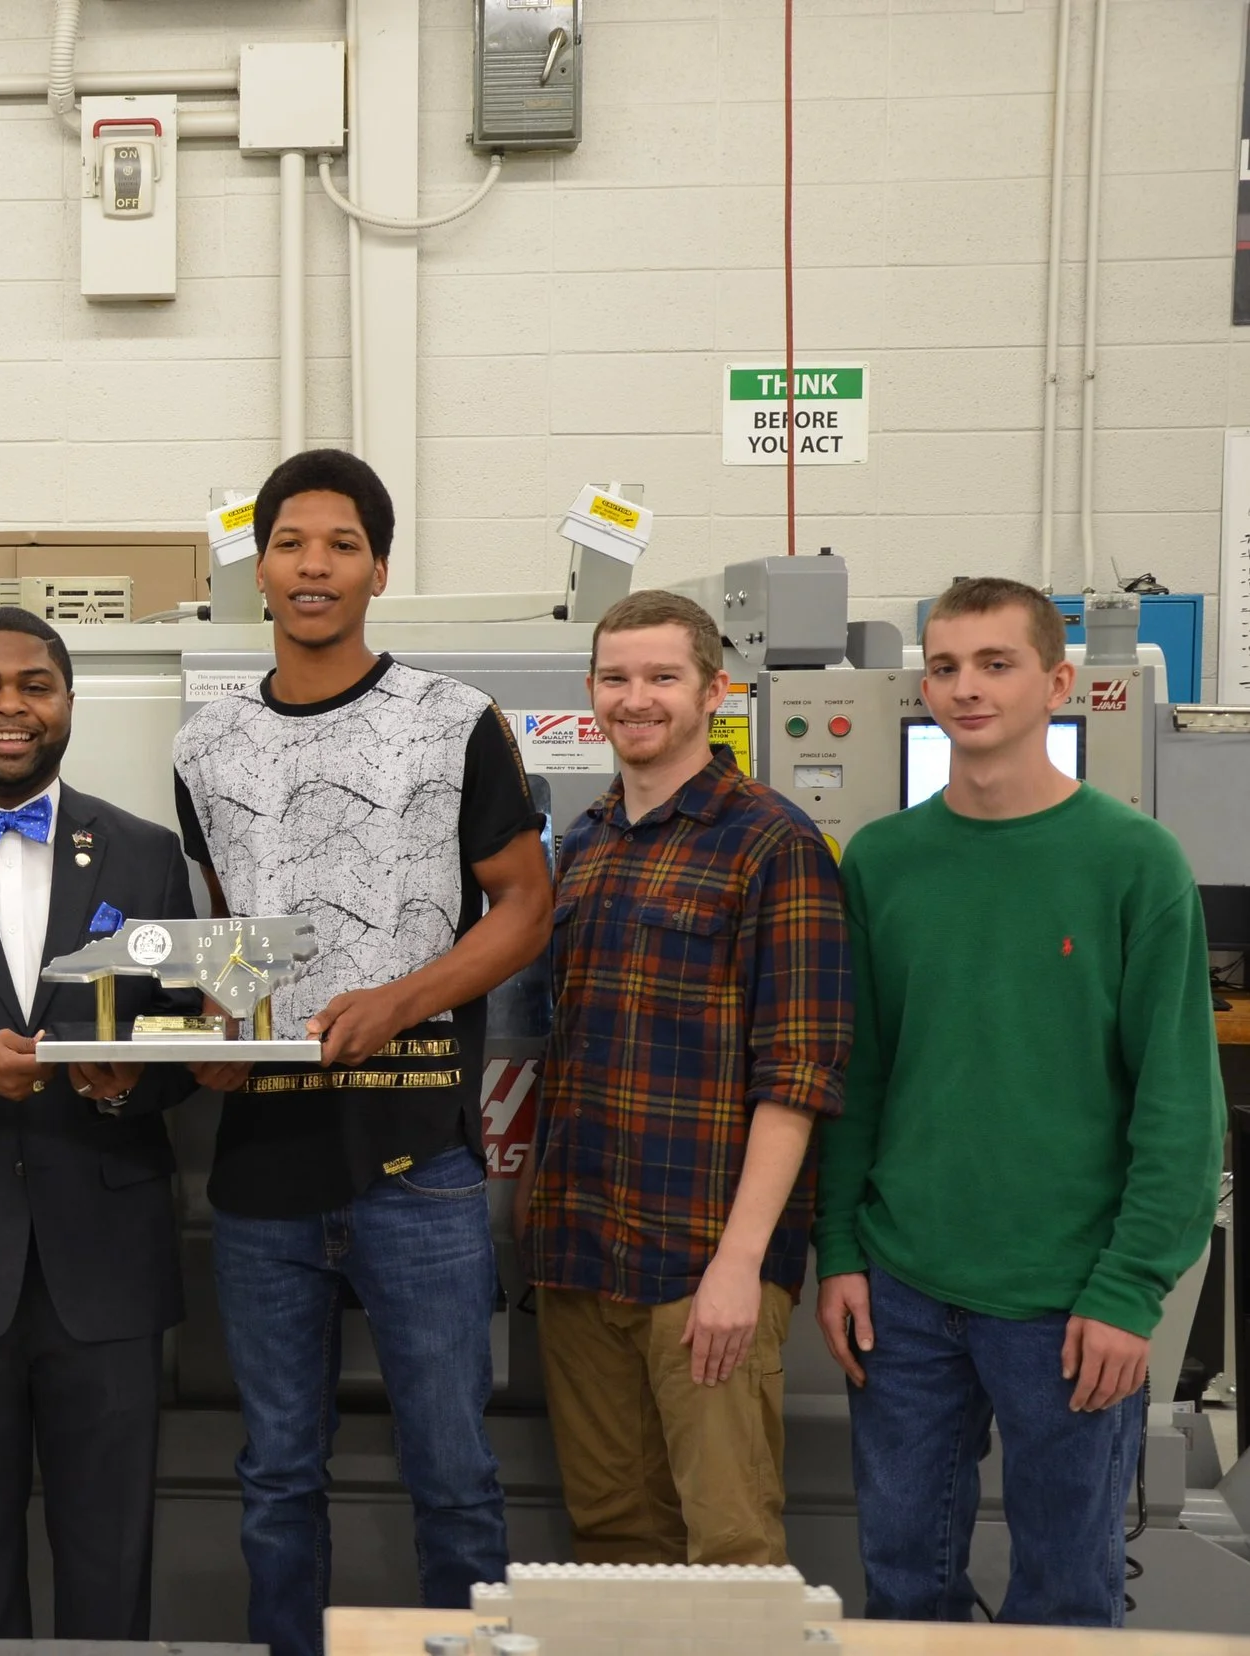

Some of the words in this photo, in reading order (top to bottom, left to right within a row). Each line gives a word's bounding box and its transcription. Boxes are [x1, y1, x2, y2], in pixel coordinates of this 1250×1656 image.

[119, 150, 138, 159] ON
[116, 198, 138, 208] OFF
[757, 374, 838, 396] THINK
[754, 411, 838, 429] BEFORE
[748, 436, 789, 453] YOU
[800, 435, 843, 453] ACT
[228, 504, 255, 517] CAUTIO
[189, 683, 218, 691] Golden
[220, 683, 247, 691] LEAF
[900, 698, 923, 706] HA
[1092, 701, 1127, 710] HAAS
[212, 925, 224, 936] 11
[228, 921, 242, 931] 12
[250, 925, 256, 936] 1
[198, 937, 212, 948] 10
[261, 937, 270, 947] 2
[196, 953, 204, 964] 9
[266, 953, 274, 964] 3
[200, 969, 208, 980] 8
[261, 969, 269, 980] 4
[213, 982, 221, 993] 7
[230, 986, 238, 996] 6
[248, 982, 256, 992] 5
[402, 1072, 452, 1086] LEGENDARY
[485, 1143, 530, 1172] AS
